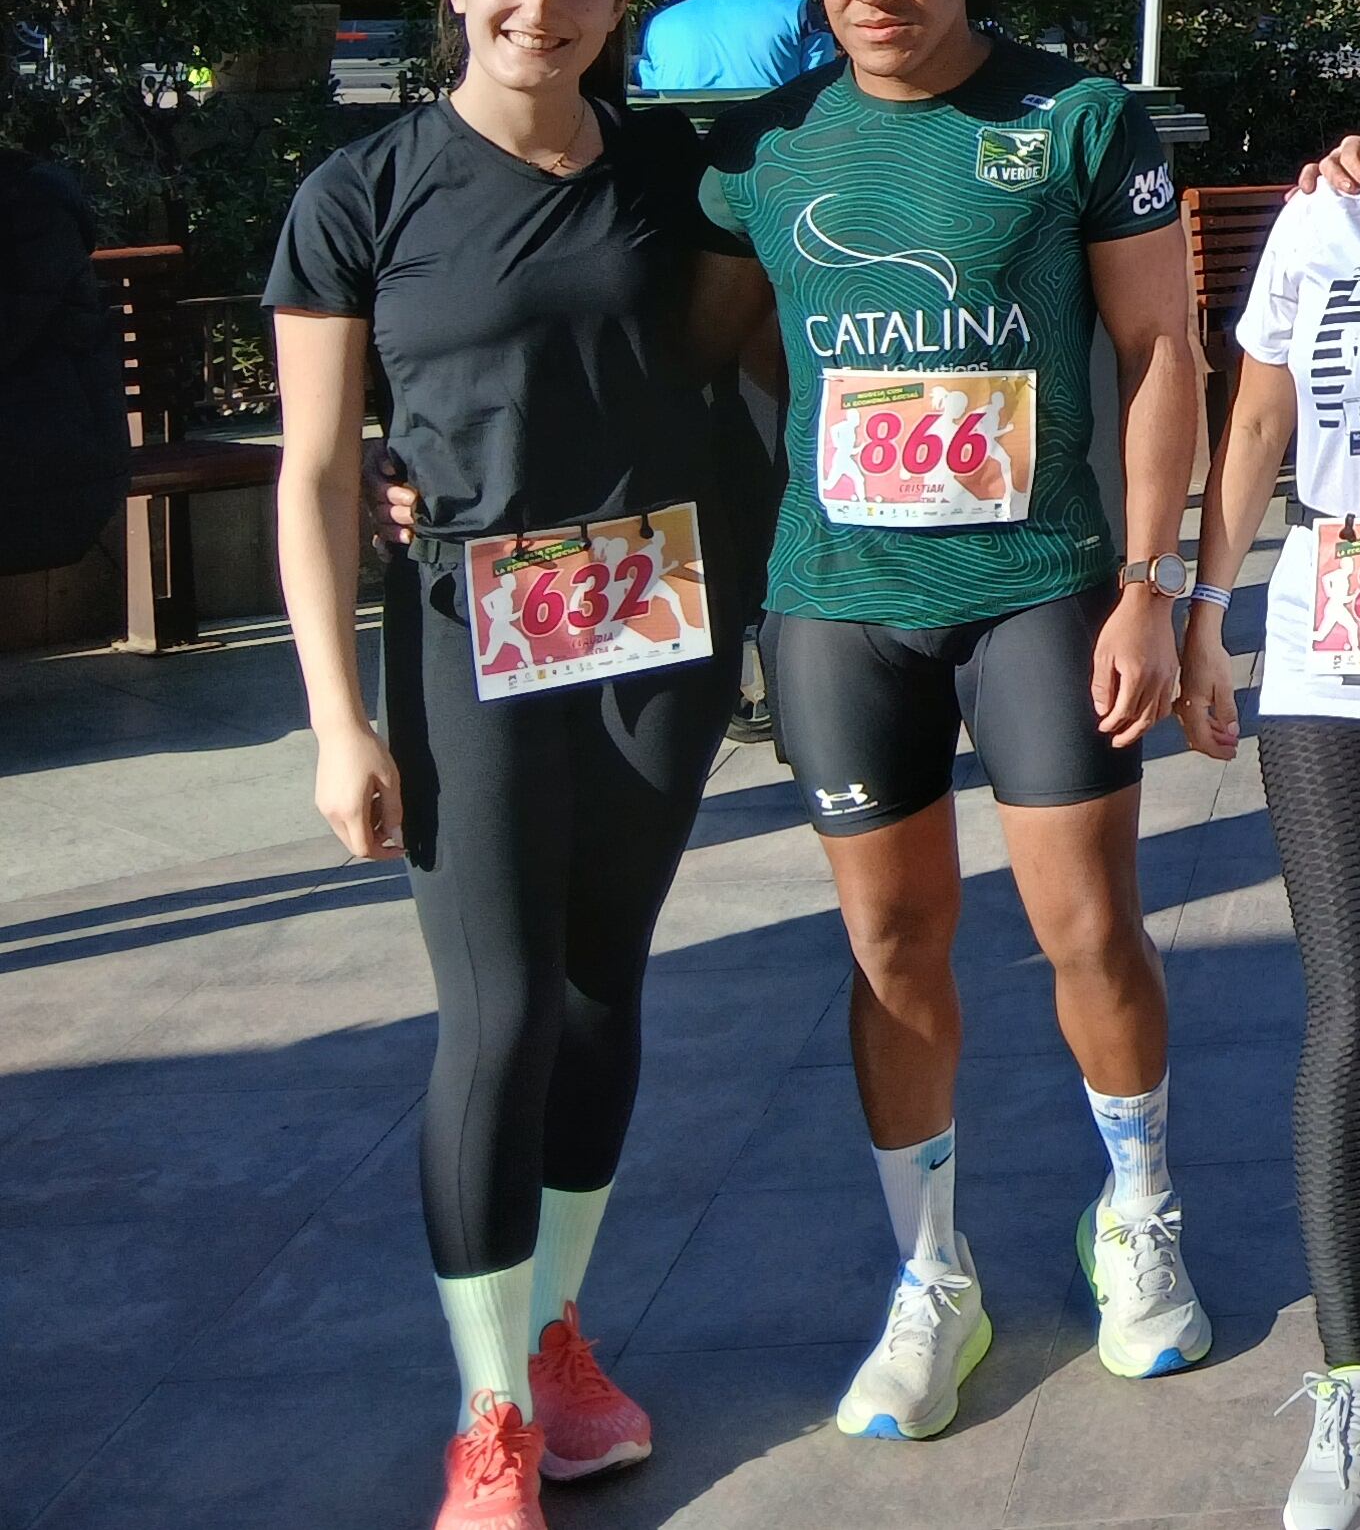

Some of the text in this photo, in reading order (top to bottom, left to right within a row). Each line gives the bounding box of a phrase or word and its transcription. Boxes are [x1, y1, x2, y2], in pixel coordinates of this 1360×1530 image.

[983, 166, 1041, 181] LA VERDE
[806, 303, 1031, 357] CATALINA
[860, 412, 988, 474] 866
[521, 554, 654, 637] 632
